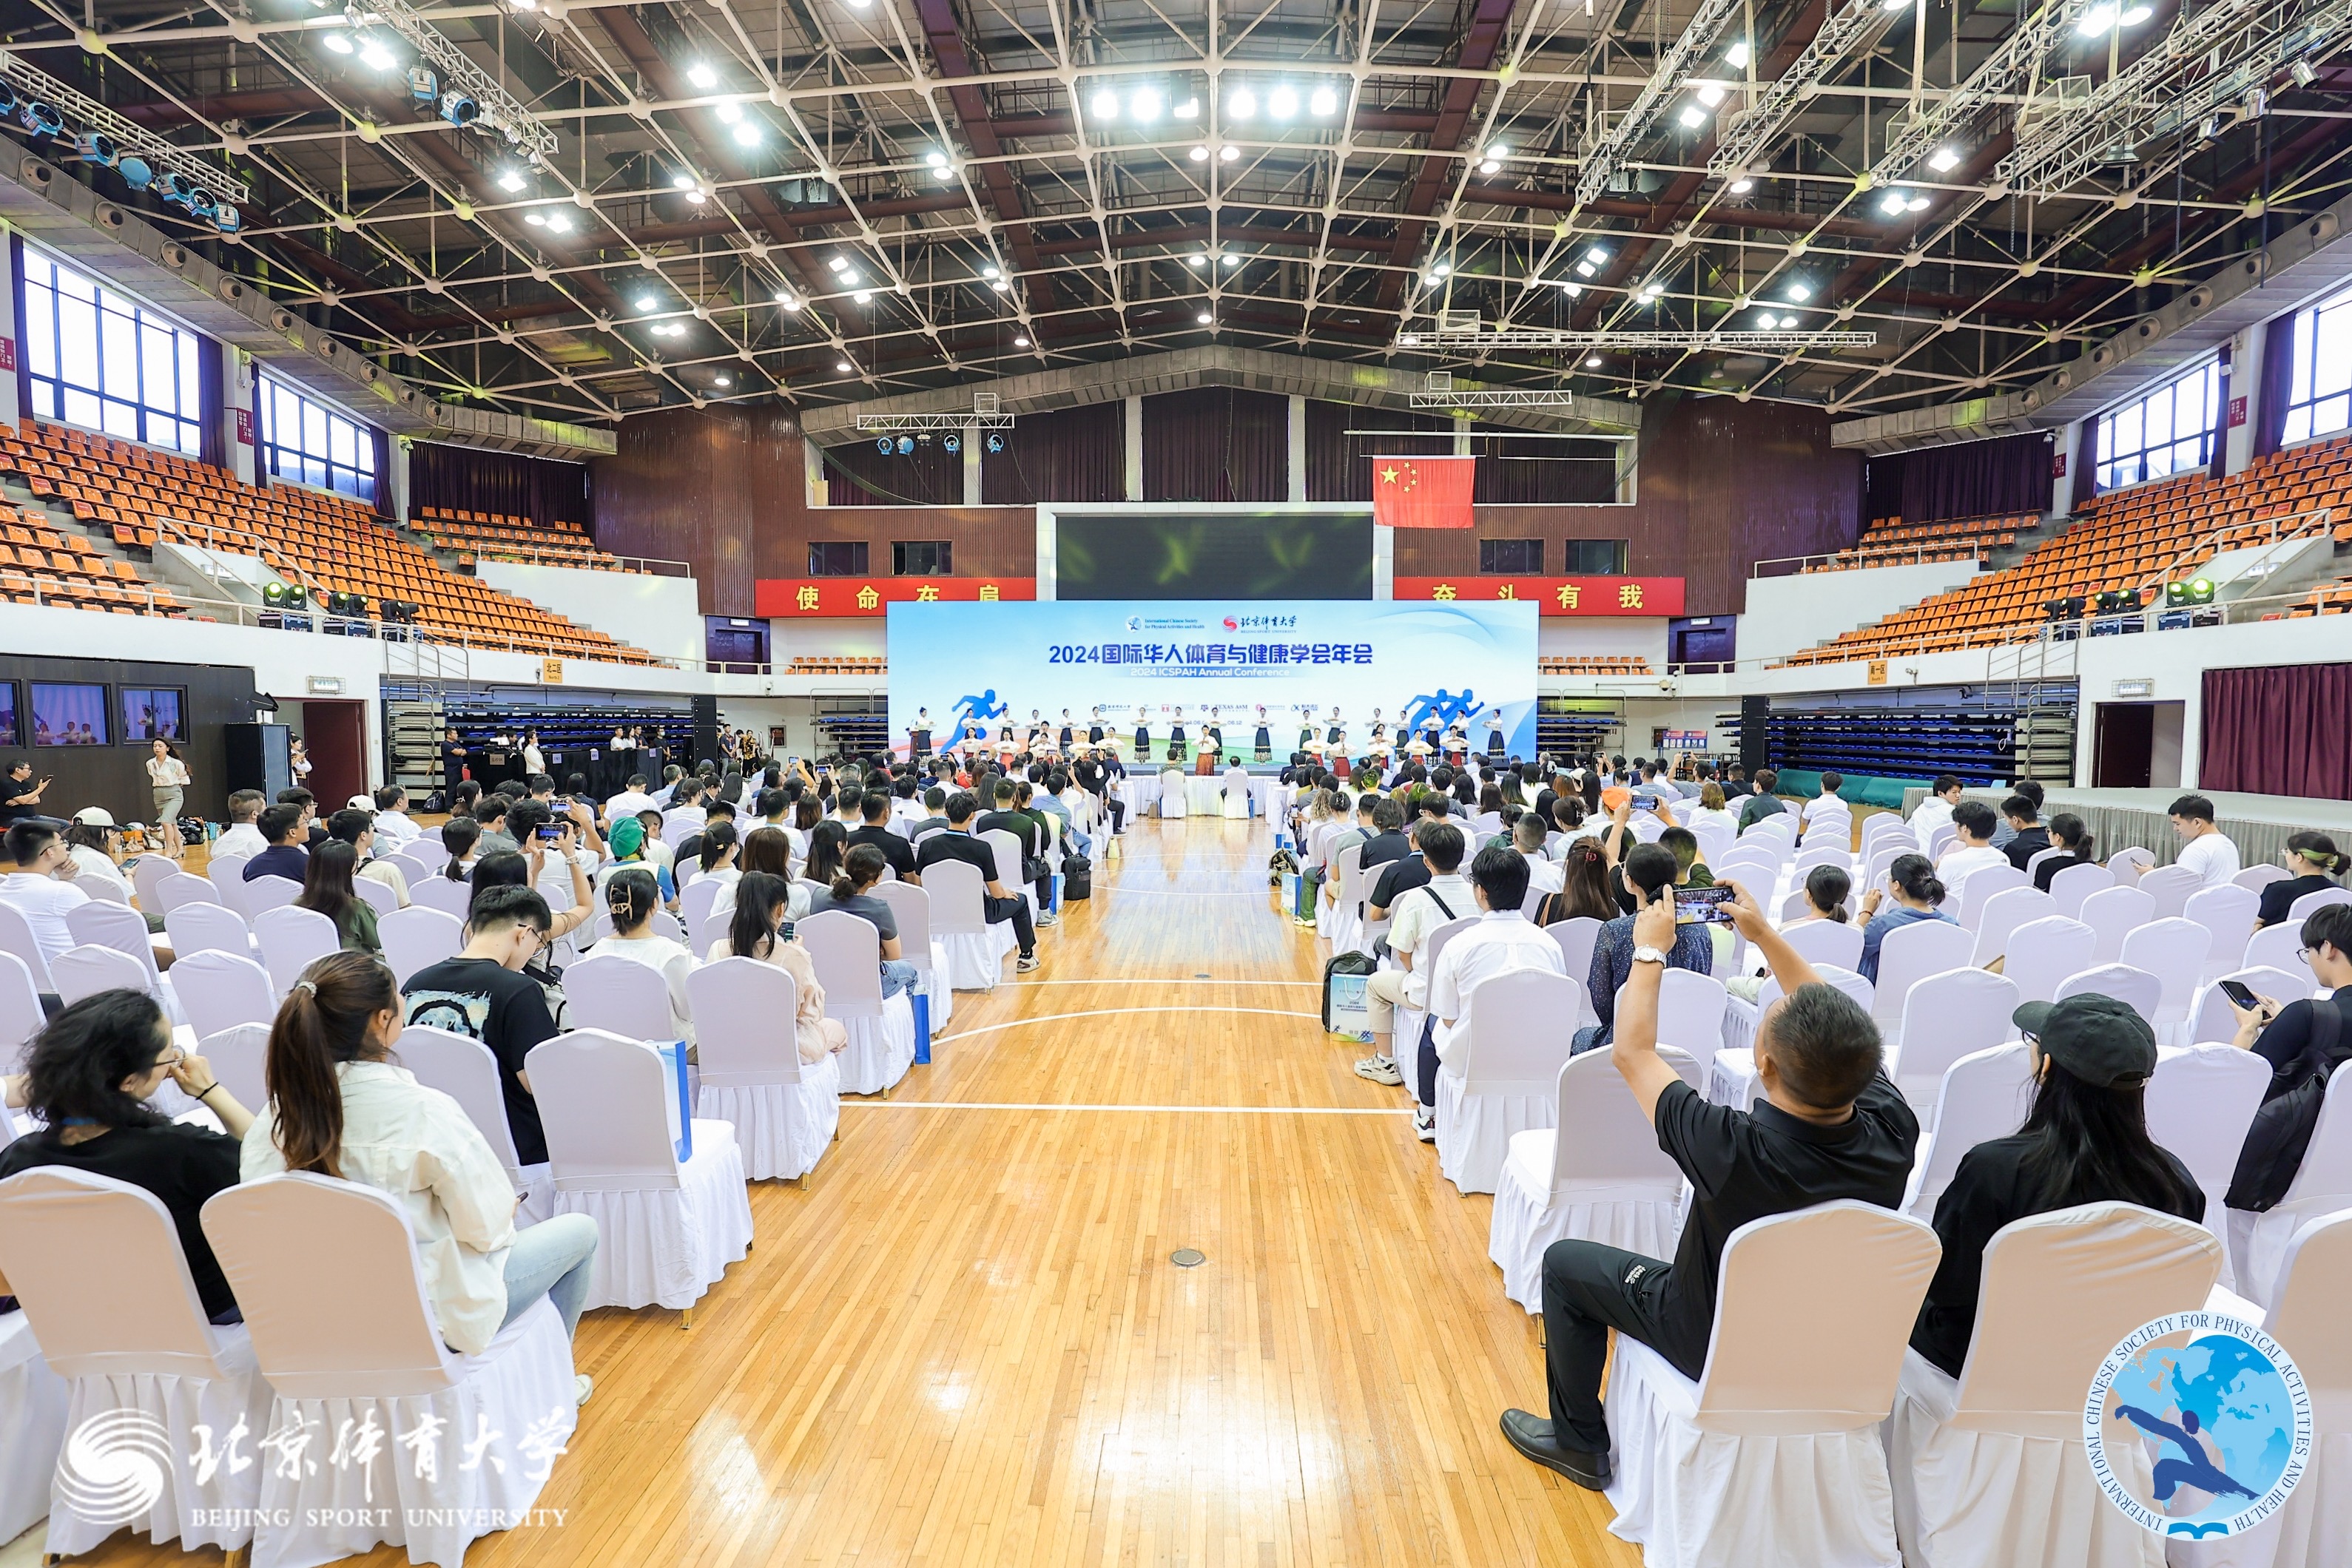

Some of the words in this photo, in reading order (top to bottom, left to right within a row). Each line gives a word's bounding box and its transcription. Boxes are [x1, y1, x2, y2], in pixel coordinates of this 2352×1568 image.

[1240, 615, 1297, 629] 北京体育大学
[1049, 643, 1372, 664] 2024国际华人体育与健康学会年会
[547, 663, 562, 673] 北二区
[1130, 668, 1156, 676] 2024
[1159, 668, 1197, 676] ICSPAH
[1199, 668, 1233, 676] Annual
[1234, 668, 1290, 676] Conference
[1870, 664, 1885, 675] 南一区
[1632, 1266, 1646, 1279] Jack
